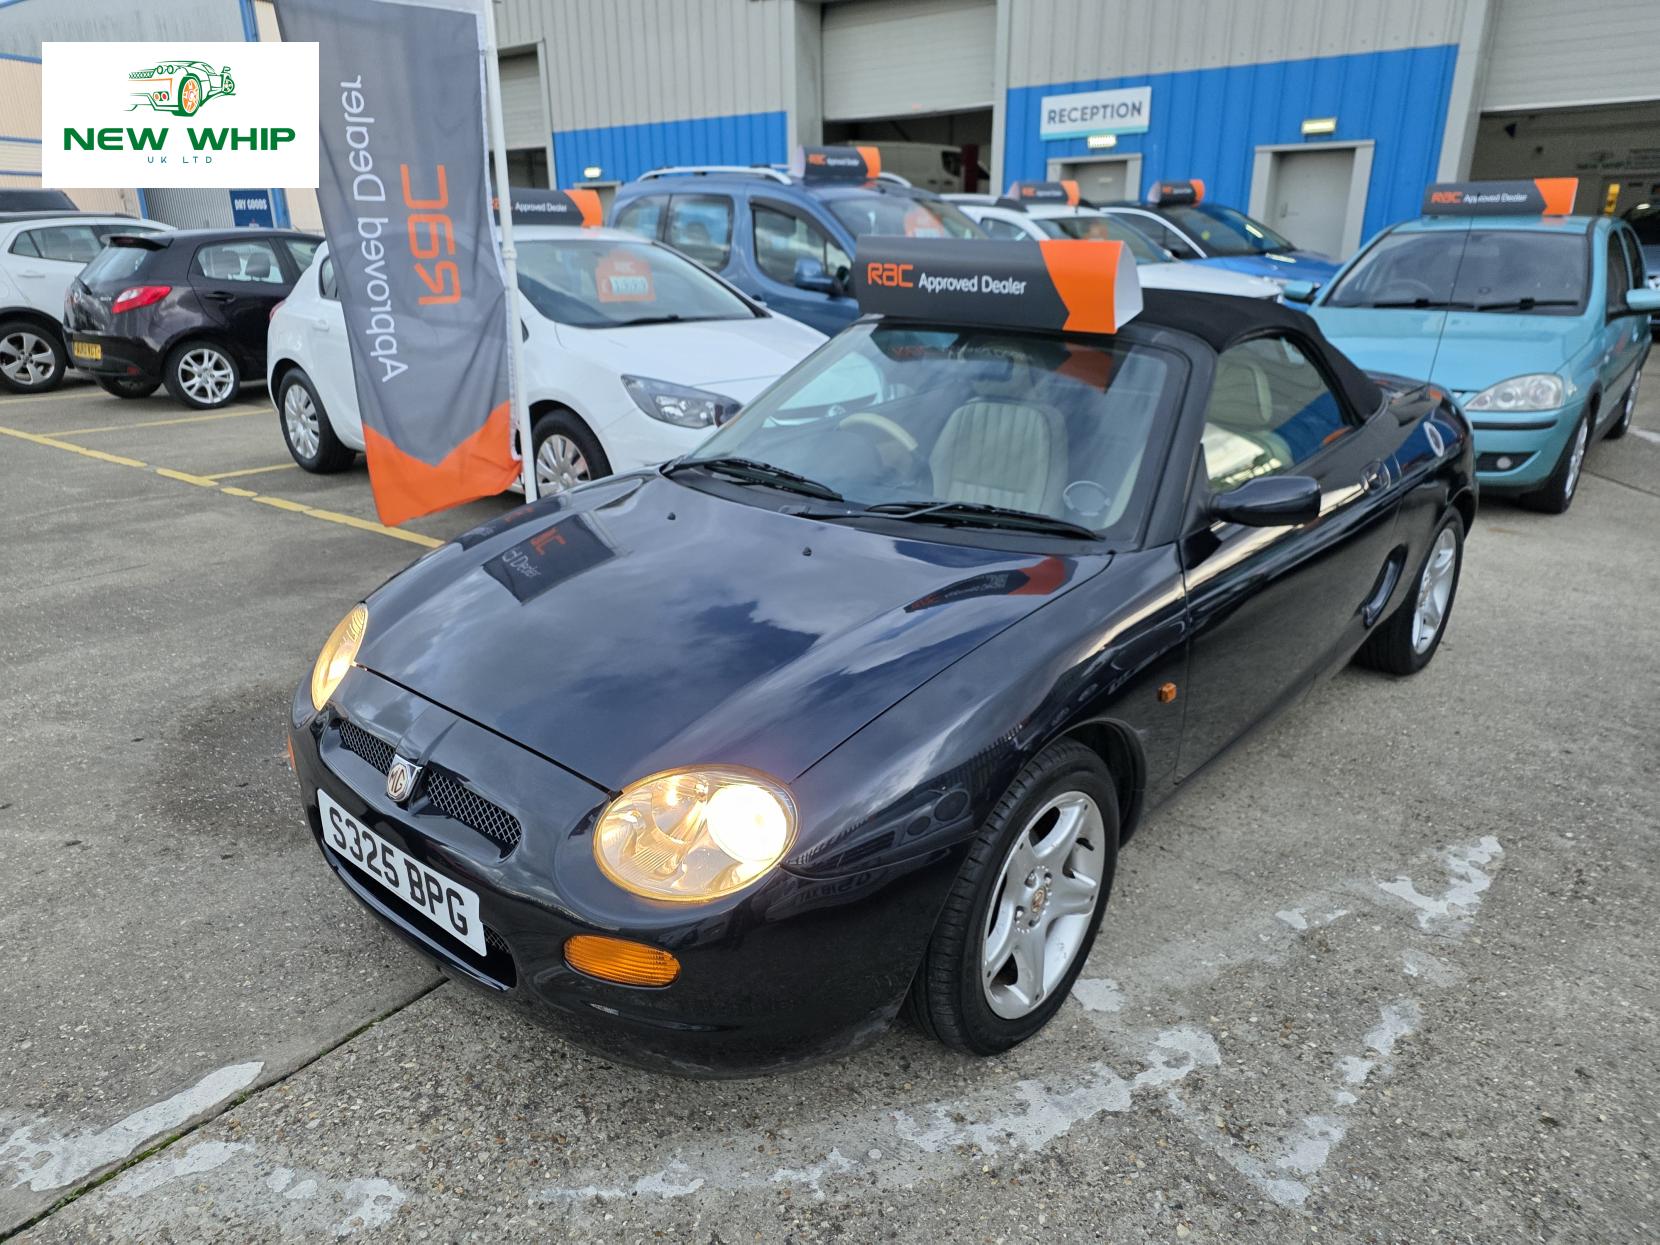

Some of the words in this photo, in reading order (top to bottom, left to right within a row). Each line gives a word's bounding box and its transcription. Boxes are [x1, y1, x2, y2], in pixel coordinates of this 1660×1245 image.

[1047, 101, 1143, 125] RECEPTION
[514, 201, 545, 213] Approved
[546, 202, 567, 212] Dealer
[918, 272, 978, 293] Approved
[981, 275, 1027, 295] Dealer
[390, 767, 406, 794] MG
[329, 806, 400, 888] S325
[403, 857, 469, 937] BPG
